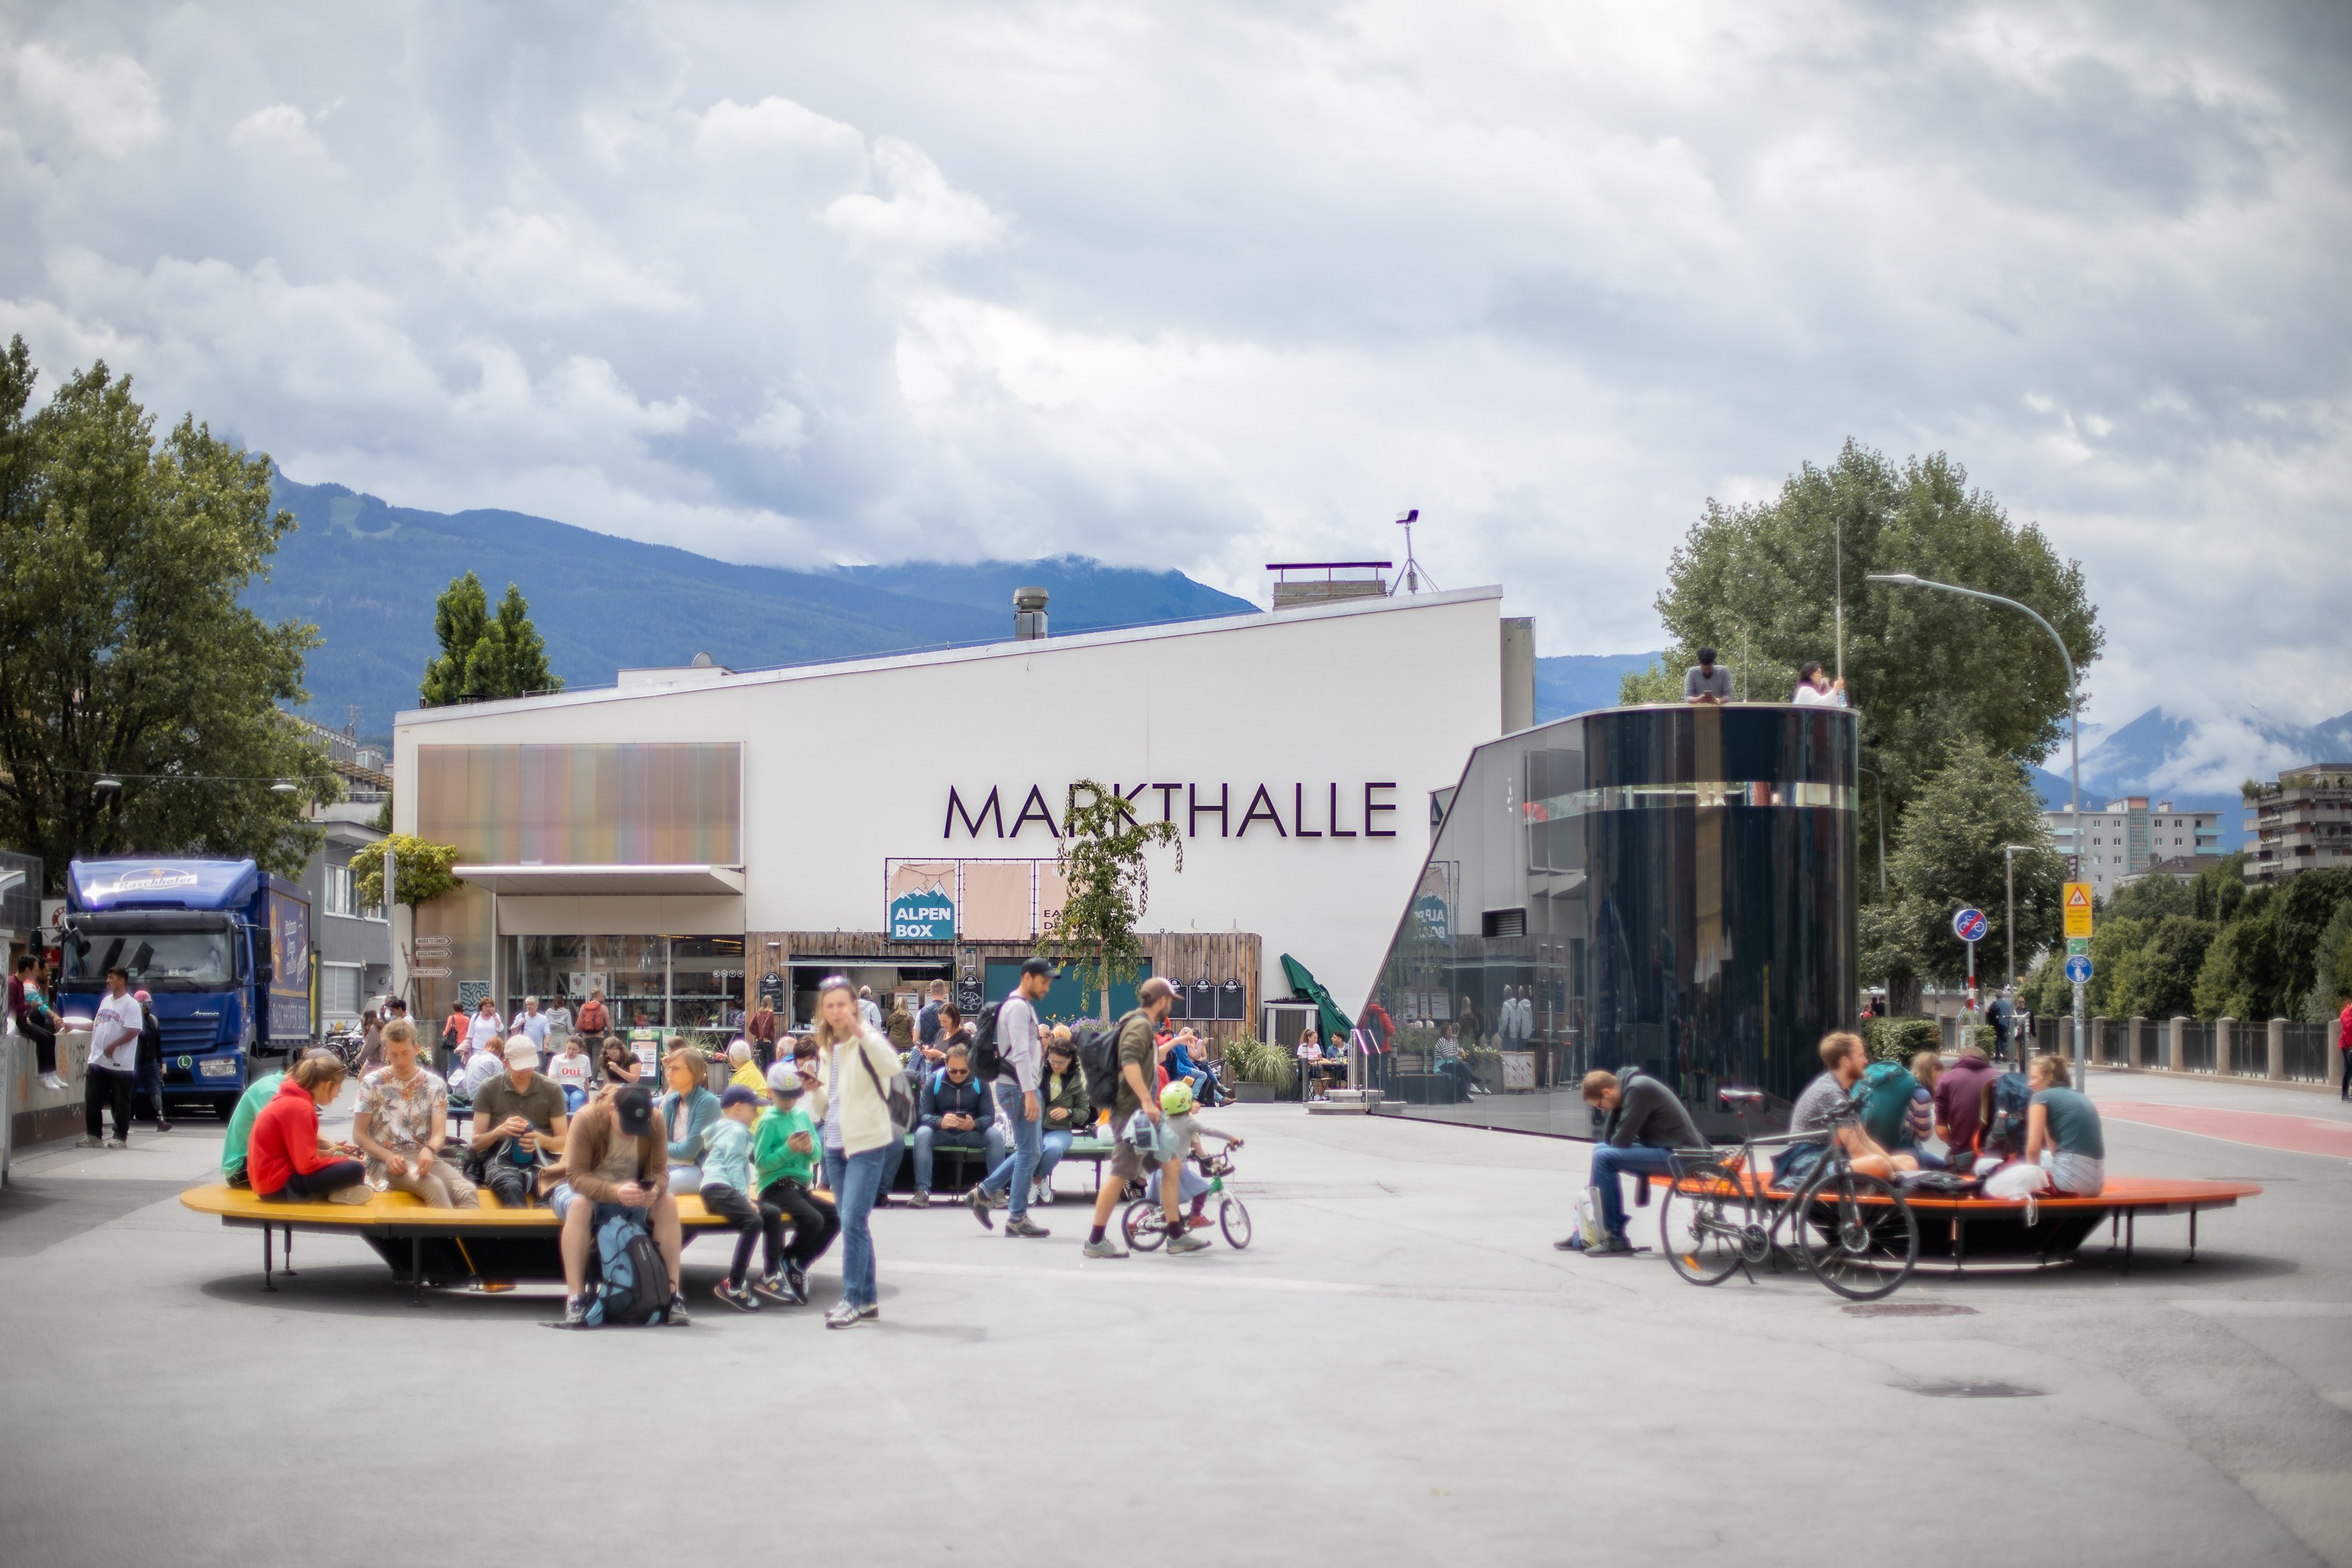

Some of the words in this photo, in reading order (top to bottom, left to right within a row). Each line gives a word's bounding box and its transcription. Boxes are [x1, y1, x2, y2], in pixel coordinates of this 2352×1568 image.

[943, 783, 1397, 838] MARKTHALLE
[895, 907, 951, 920] ALPEN
[896, 924, 934, 938] BOX
[181, 1058, 188, 1066] L
[561, 1067, 581, 1076] Oui
